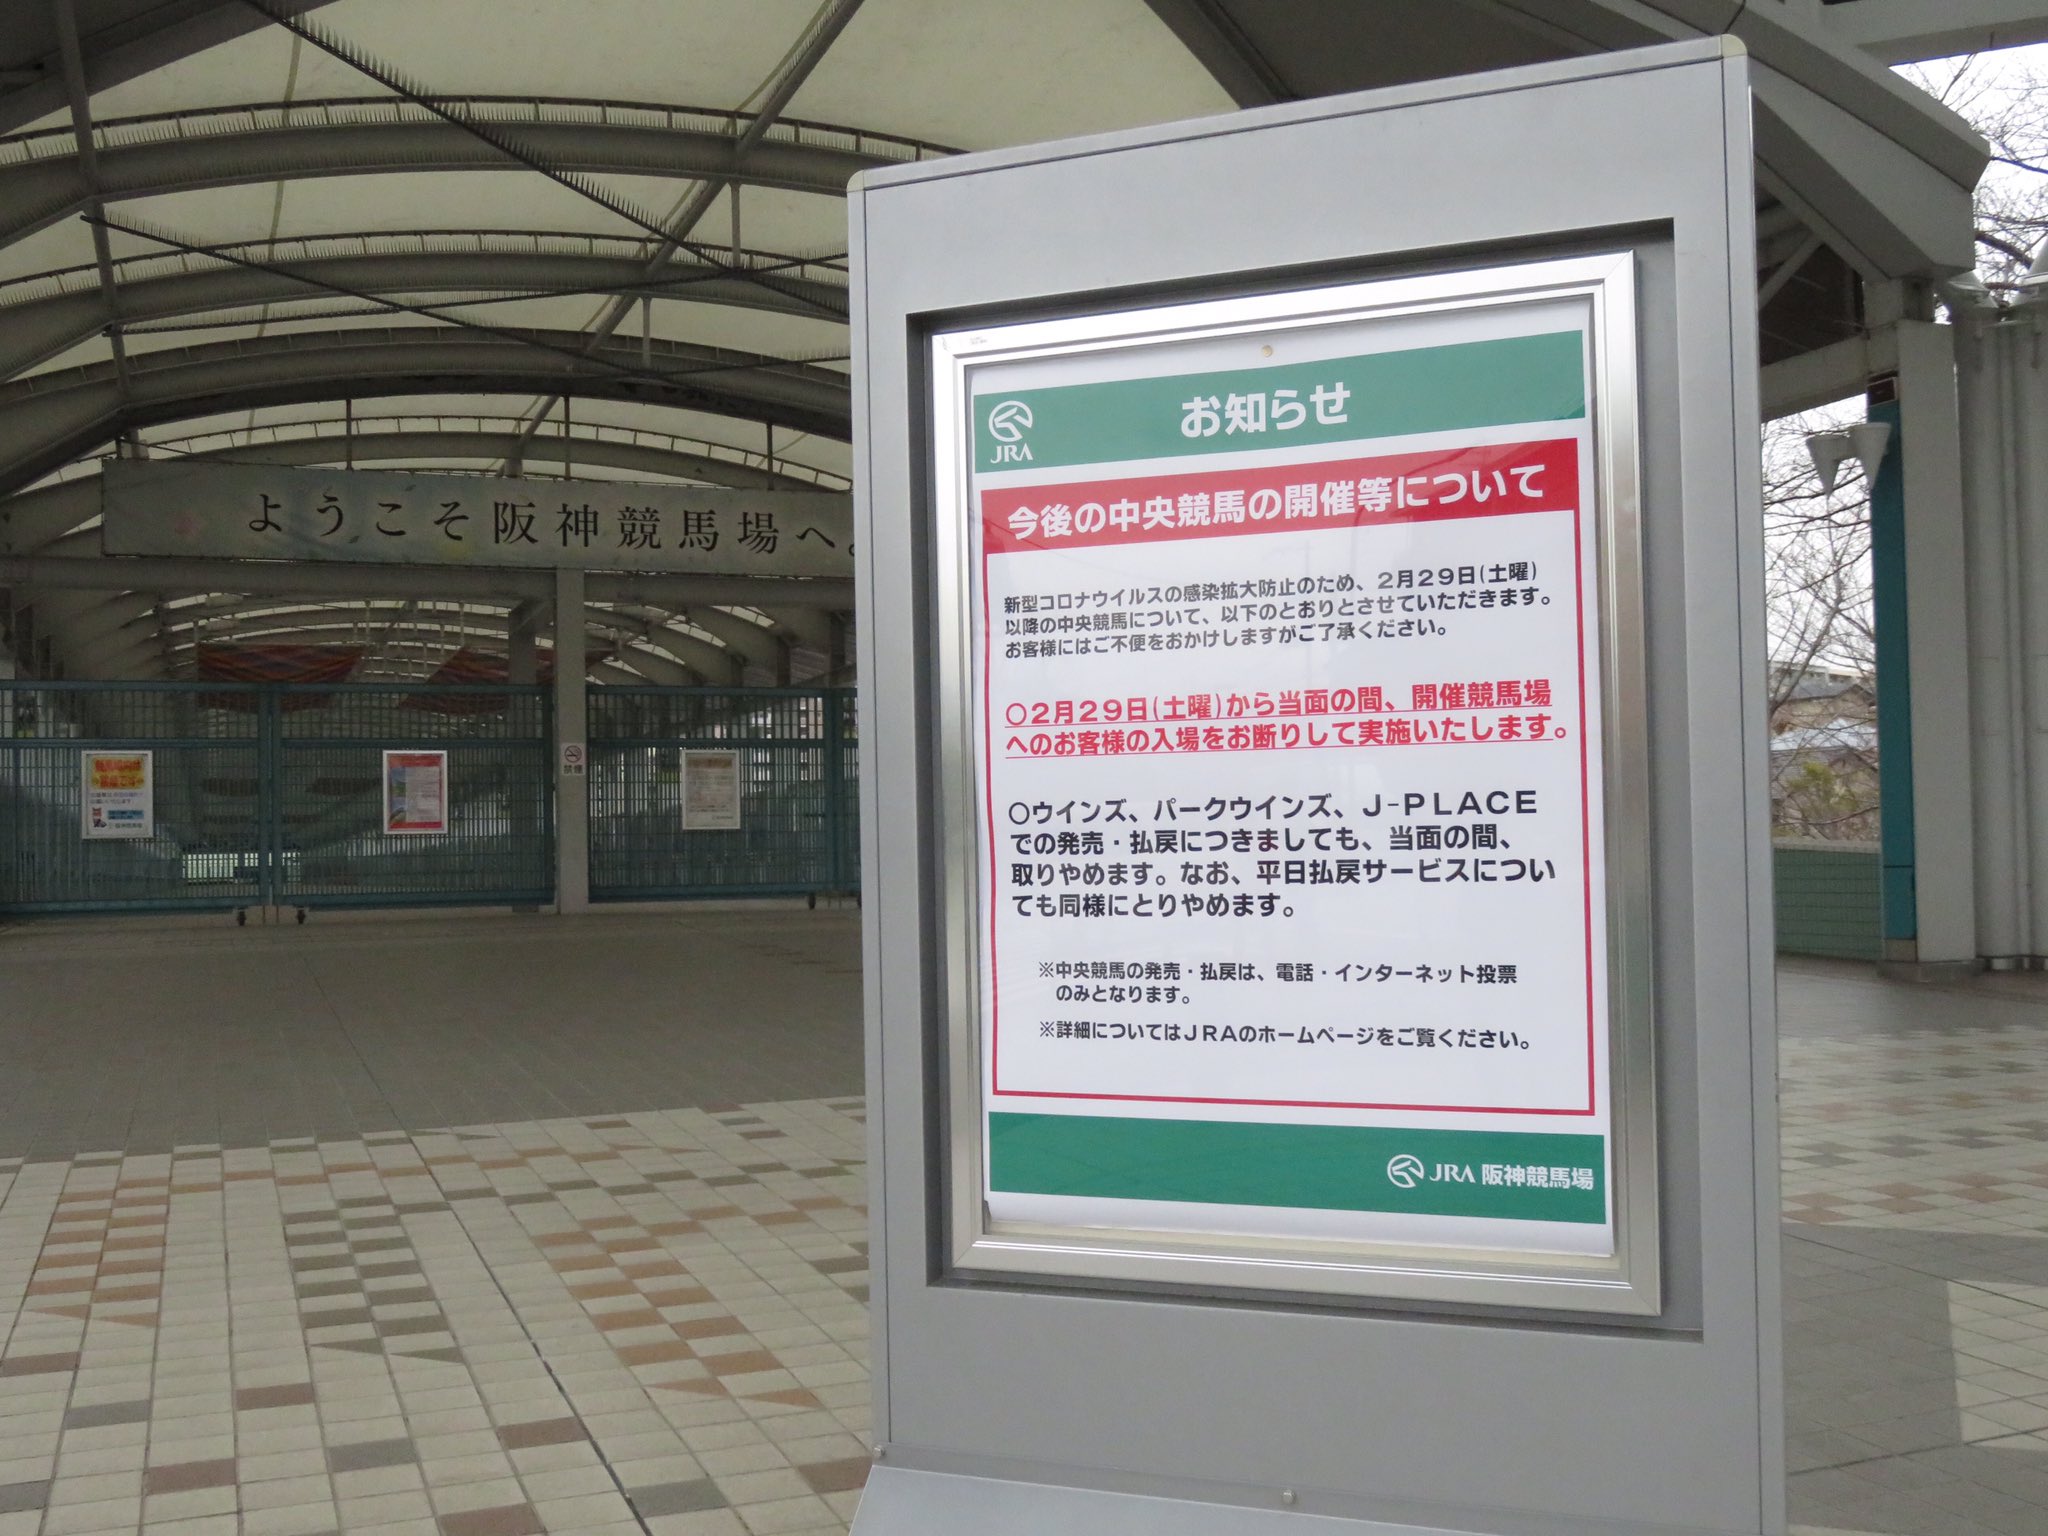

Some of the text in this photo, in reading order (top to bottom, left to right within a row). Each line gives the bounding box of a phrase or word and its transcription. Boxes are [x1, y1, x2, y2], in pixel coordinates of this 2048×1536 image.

[1181, 382, 1351, 438] お知らせ
[990, 443, 1034, 464] JRA
[1007, 464, 1546, 541] 今後の中央競馬の開催等について
[1005, 618, 1447, 660] お客様にはご不便をおかけしますがご了承ください。
[1006, 713, 1567, 756] へのお客様の入場をお断りして実施いたします。
[1010, 824, 1511, 856] での発売・払戻につきましても、当面の間、
[1011, 857, 1556, 887] 取りやめます。なお、平日払戻サービスについ
[1012, 892, 1294, 918] ても同様にとりやめます。
[1056, 985, 1190, 1005] のみとなります。
[1429, 1163, 1594, 1190] JRA 阪神競馬場
